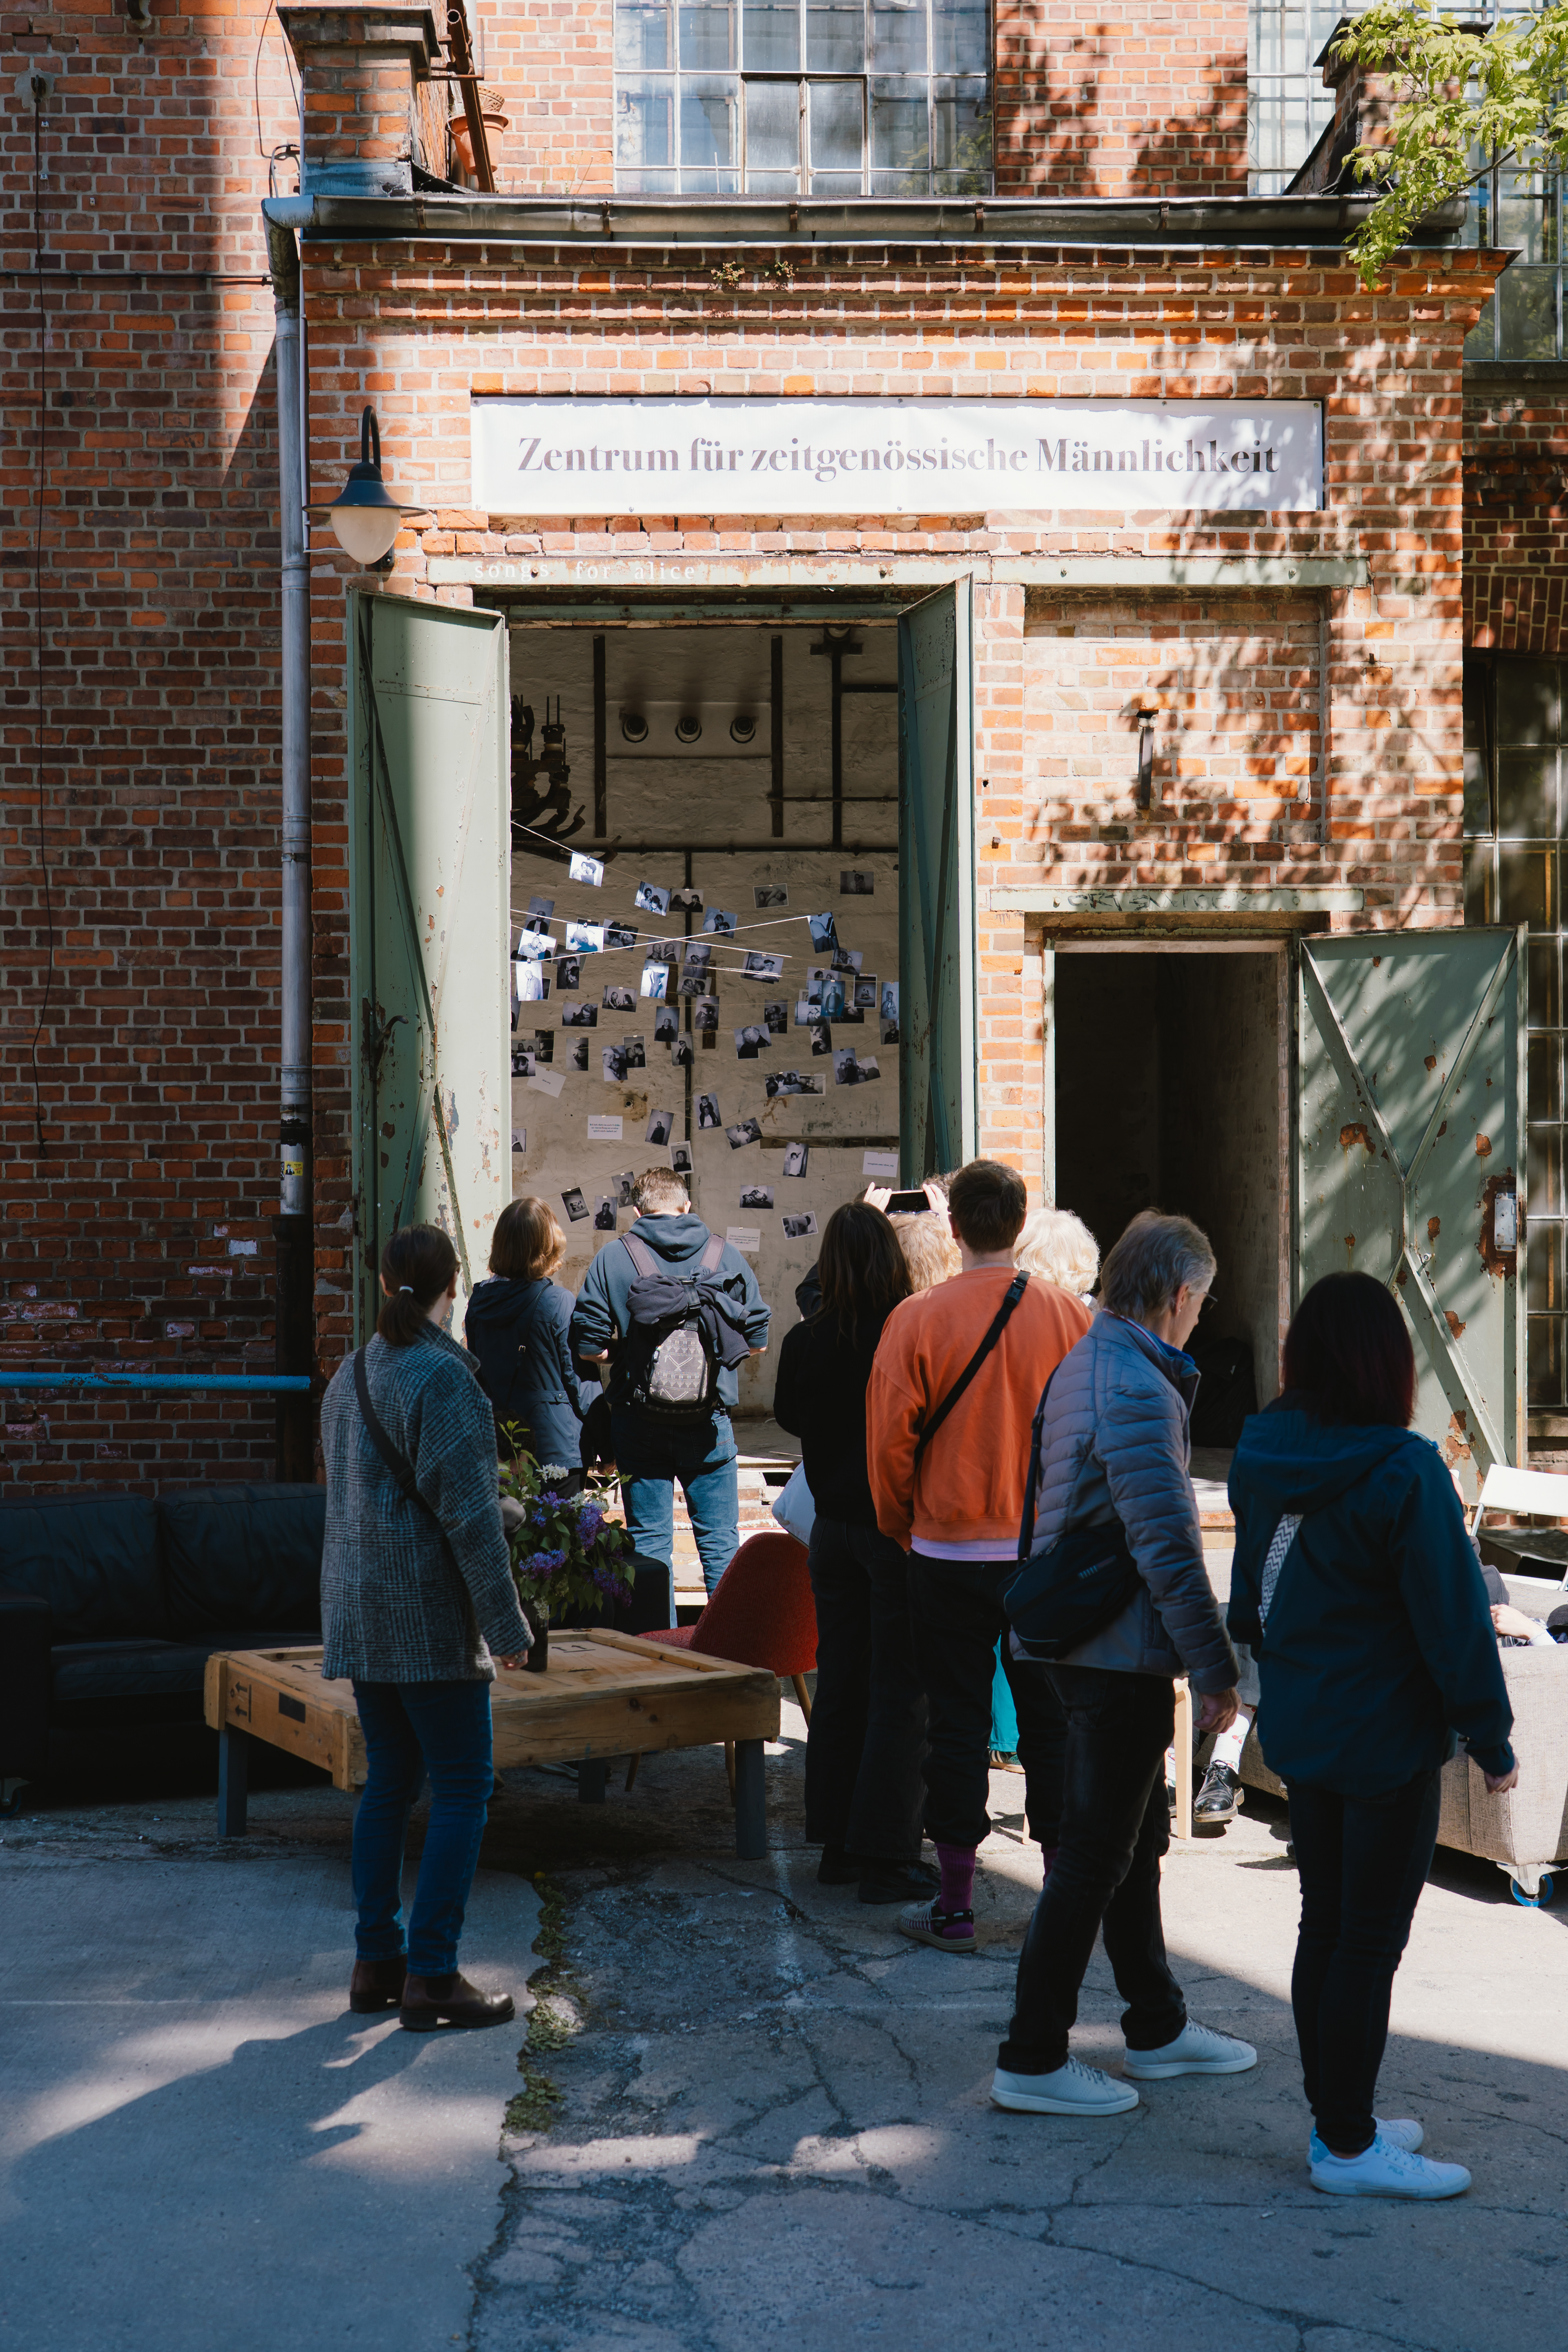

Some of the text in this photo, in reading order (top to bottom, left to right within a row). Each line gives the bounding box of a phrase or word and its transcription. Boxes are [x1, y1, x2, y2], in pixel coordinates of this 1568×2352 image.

[517, 437, 1279, 482] Zentrum für zeitgenössische Männlichkeit
[474, 561, 695, 582] songs for alice
